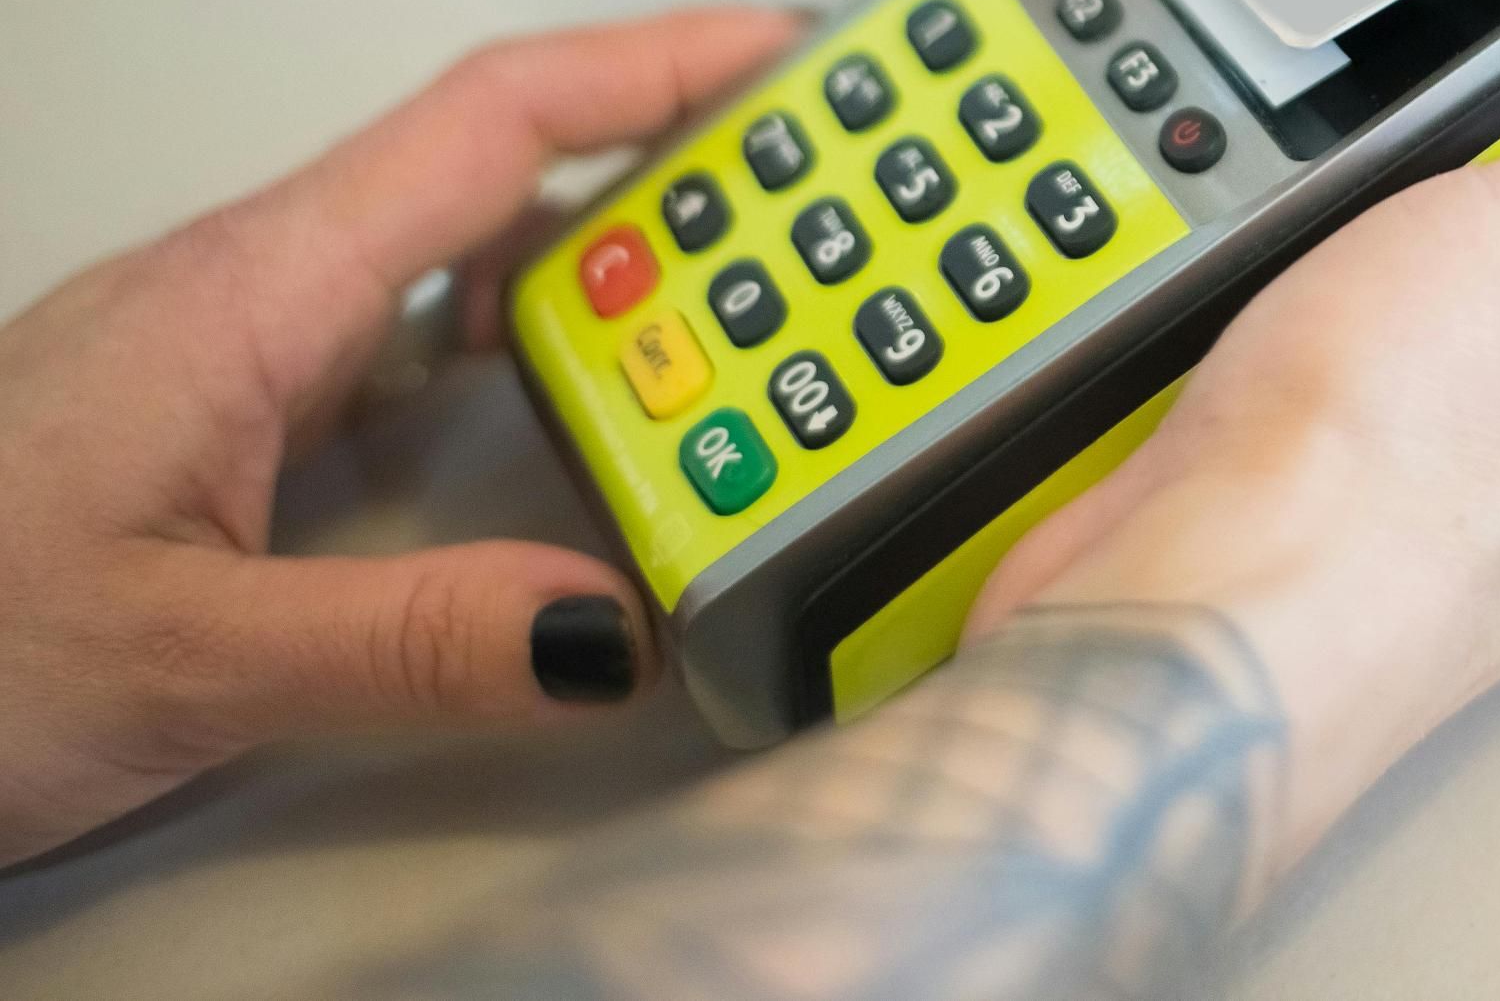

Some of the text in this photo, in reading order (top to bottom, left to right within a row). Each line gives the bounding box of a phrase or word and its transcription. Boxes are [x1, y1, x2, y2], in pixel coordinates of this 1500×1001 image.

[1118, 50, 1159, 88] F3
[981, 104, 1023, 142] 2
[899, 167, 942, 201] 5
[1055, 169, 1100, 232] DEF 3
[817, 230, 856, 265] 8
[970, 234, 1014, 299] MNO 6
[720, 281, 761, 318] 0
[881, 293, 926, 362] WXYZ 9
[695, 427, 743, 480] OK
